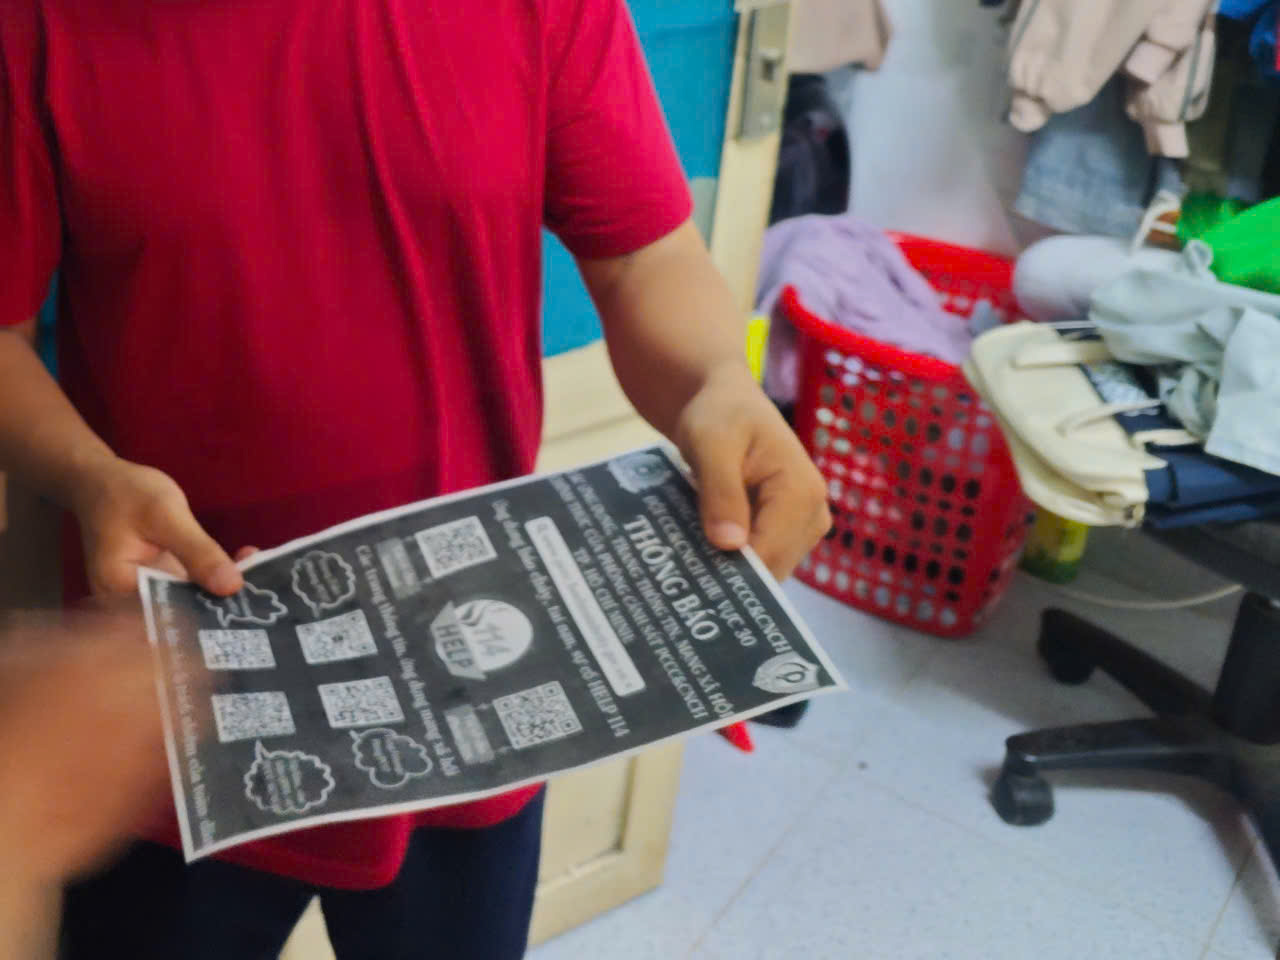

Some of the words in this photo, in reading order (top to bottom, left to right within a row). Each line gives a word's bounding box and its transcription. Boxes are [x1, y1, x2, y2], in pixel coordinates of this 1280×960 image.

[615, 512, 700, 596] THÔNG
[667, 591, 731, 642] BÁO
[693, 574, 726, 601] KHU
[468, 618, 517, 660] 114
[709, 599, 747, 629] VỰC
[721, 574, 795, 653] PCCC&CNCH
[731, 627, 761, 648] 30
[432, 621, 479, 672] HELP
[650, 646, 710, 719] PCCC&CNCH
[584, 678, 622, 717] HELP
[603, 713, 634, 739] 114
